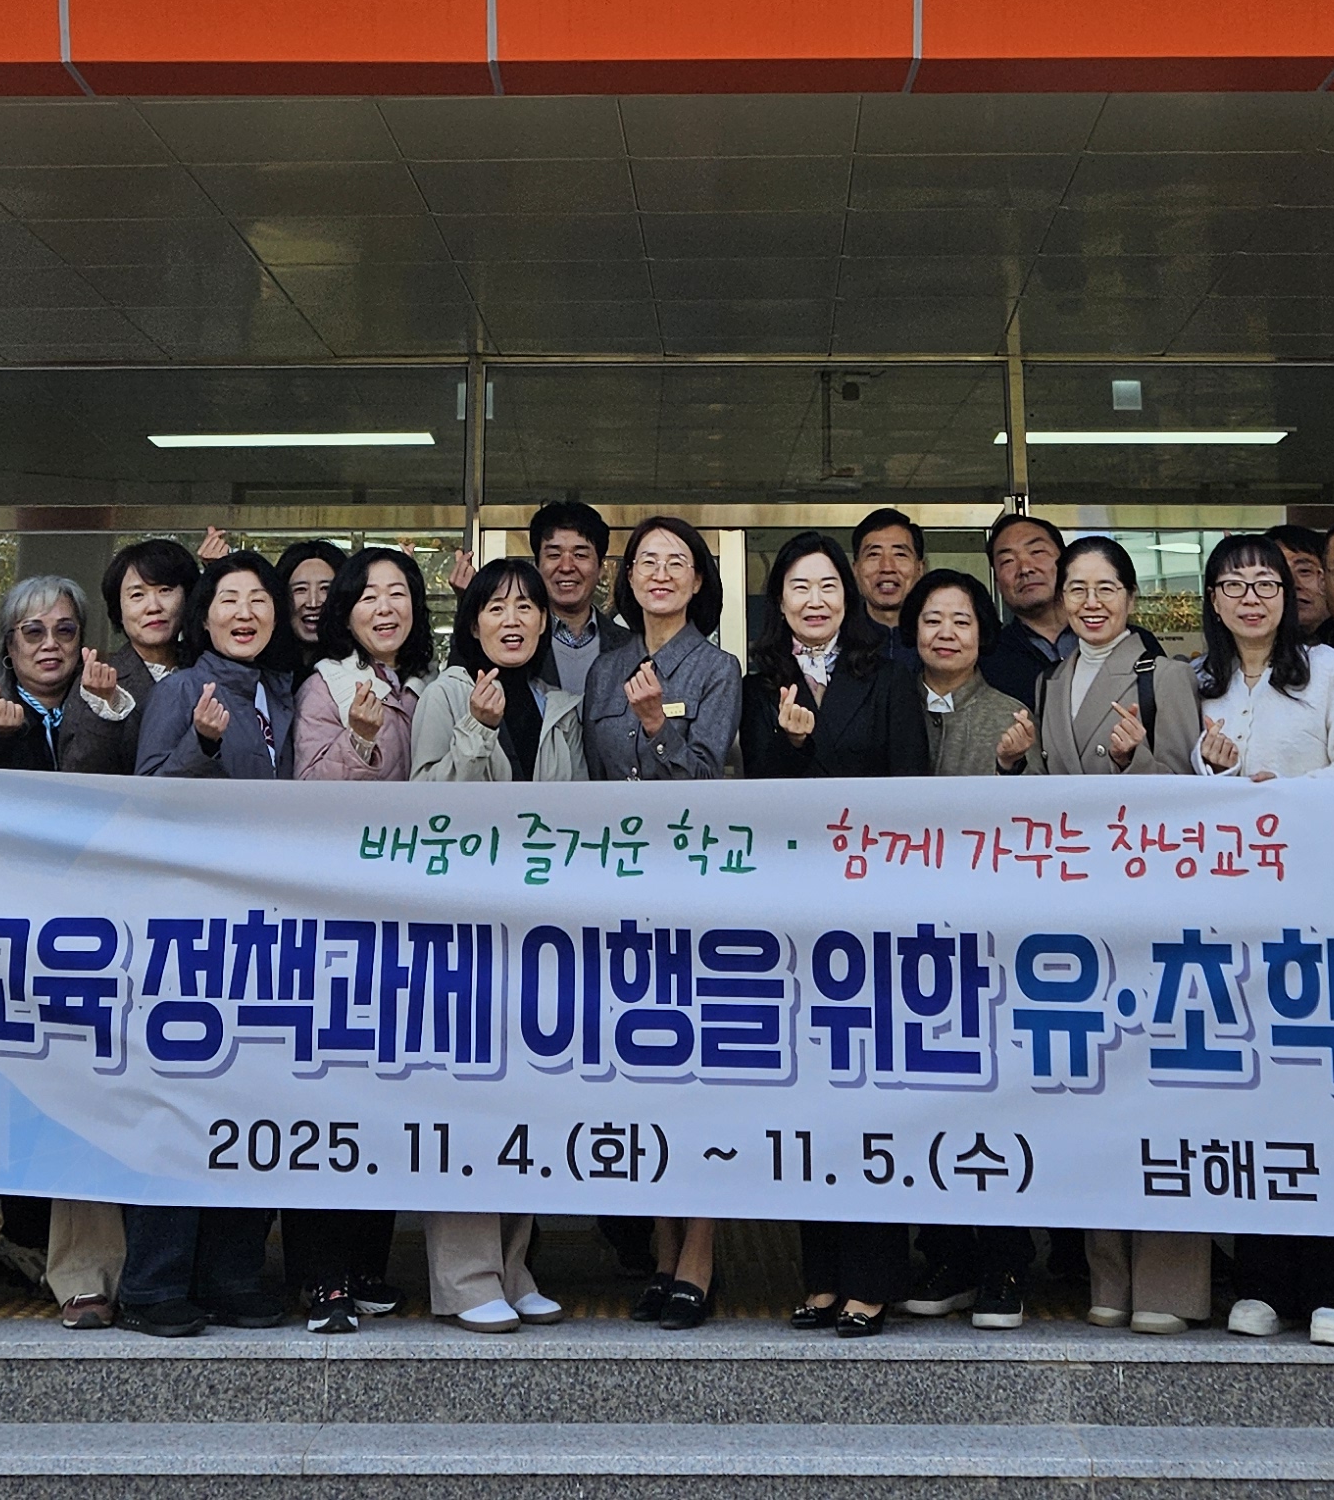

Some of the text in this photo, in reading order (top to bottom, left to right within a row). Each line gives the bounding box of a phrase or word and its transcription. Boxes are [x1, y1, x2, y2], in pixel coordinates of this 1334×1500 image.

[359, 814, 501, 876] 배움이
[517, 812, 650, 885] 즐거운
[667, 808, 758, 877] 학교
[826, 807, 945, 880] 함께
[961, 811, 1091, 882] 가꾸는
[1107, 804, 1289, 883] 창녕교육
[142, 908, 495, 1065] 정책과제
[518, 919, 784, 1070] 이행을
[809, 922, 991, 1074] 위한
[207, 1117, 379, 1176] 2025.
[402, 1121, 474, 1179] 11.
[496, 1121, 670, 1186] 4.(화)
[765, 1129, 837, 1186] 11.
[861, 1130, 1035, 1194] 5.(수)
[1140, 1137, 1322, 1204] 남해군
